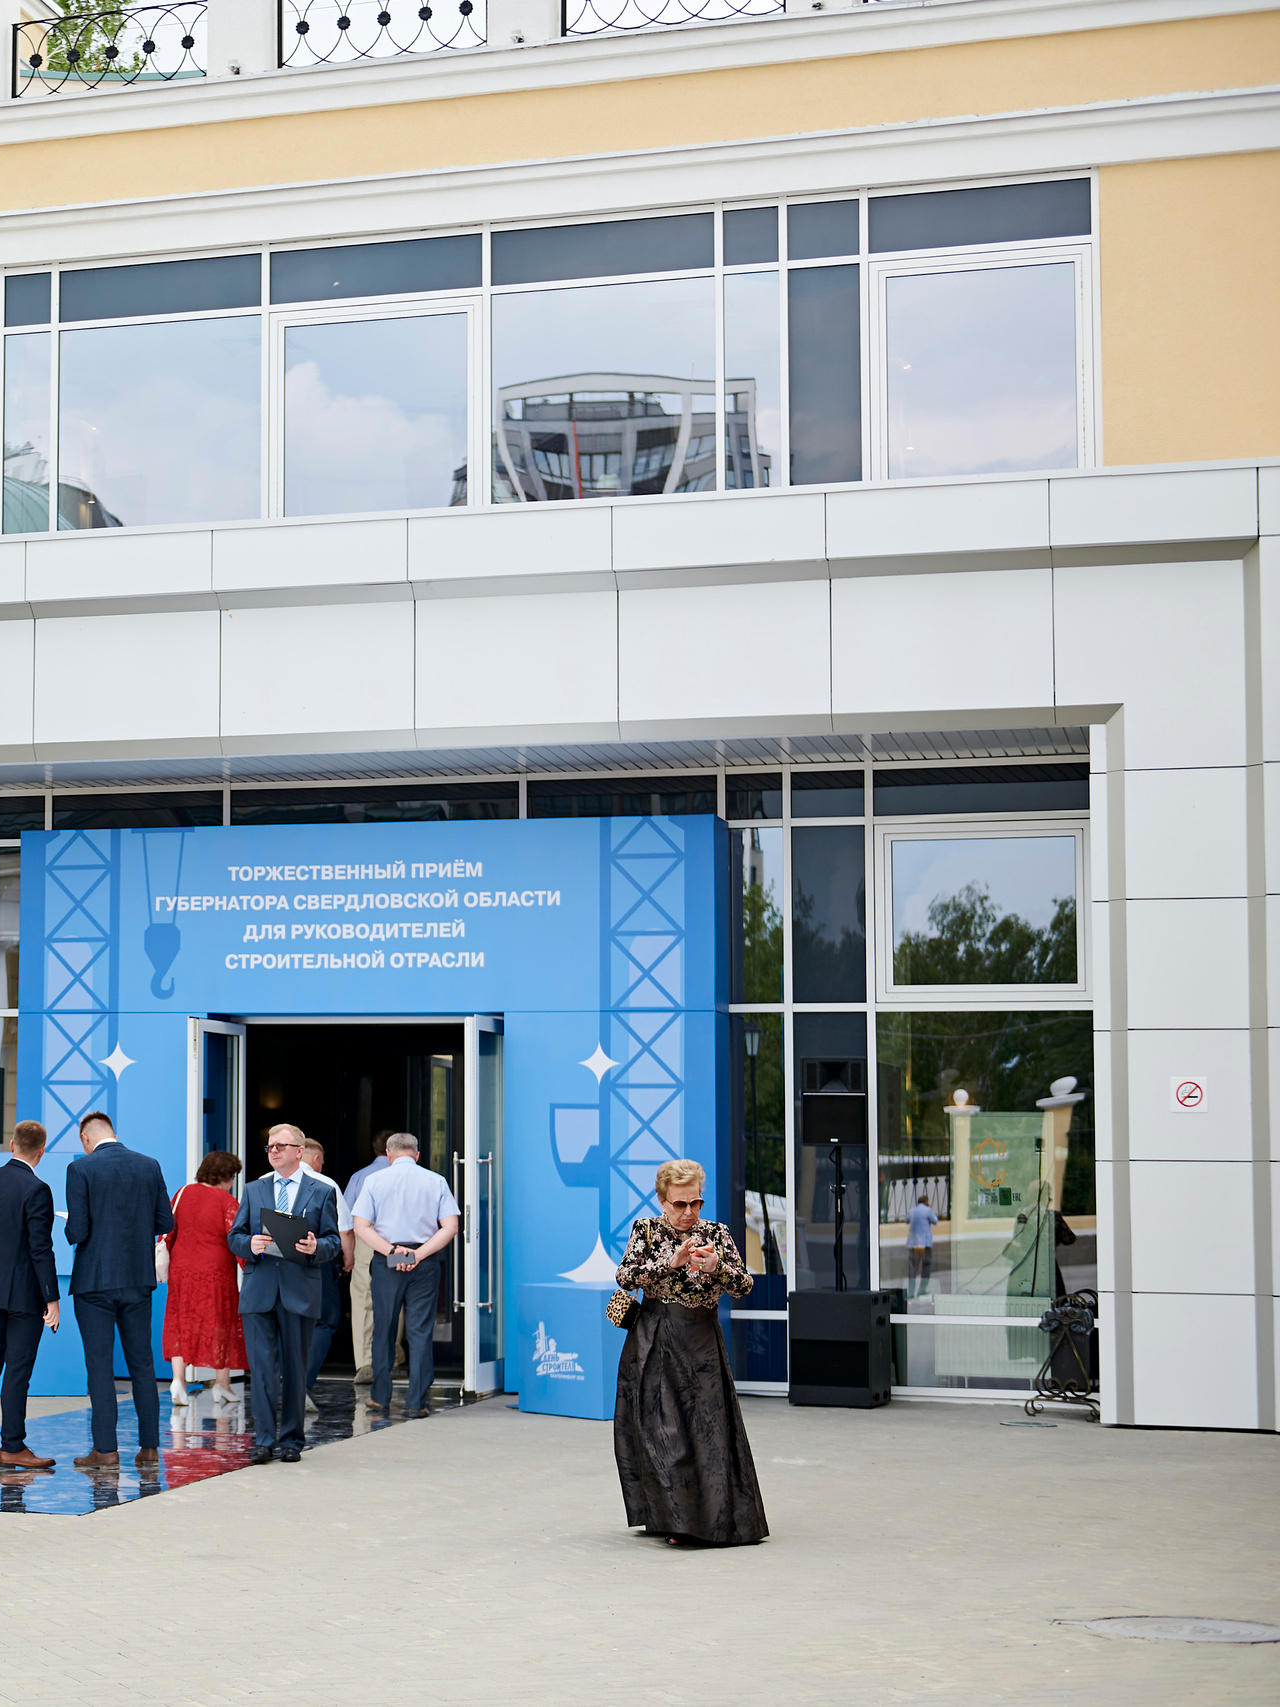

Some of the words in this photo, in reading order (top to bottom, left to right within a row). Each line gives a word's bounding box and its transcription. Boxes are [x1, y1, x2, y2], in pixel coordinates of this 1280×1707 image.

[228, 860, 406, 881] ТОРЖЕСТВЕННЫЙ
[411, 859, 483, 879] ПРИЁМ
[155, 894, 290, 912] ГУБЕРНАТОРА
[293, 889, 458, 912] СВЕРДЛОВСКОЙ
[463, 890, 561, 908] ОБЛАСТИ
[243, 924, 286, 943] ДЛЯ
[291, 919, 465, 942] РУКОВОДИТЕЛЕЙ
[225, 949, 384, 970] СТРОИТЕЛЬНОЙ
[389, 952, 485, 968] ОТРАСЛИ
